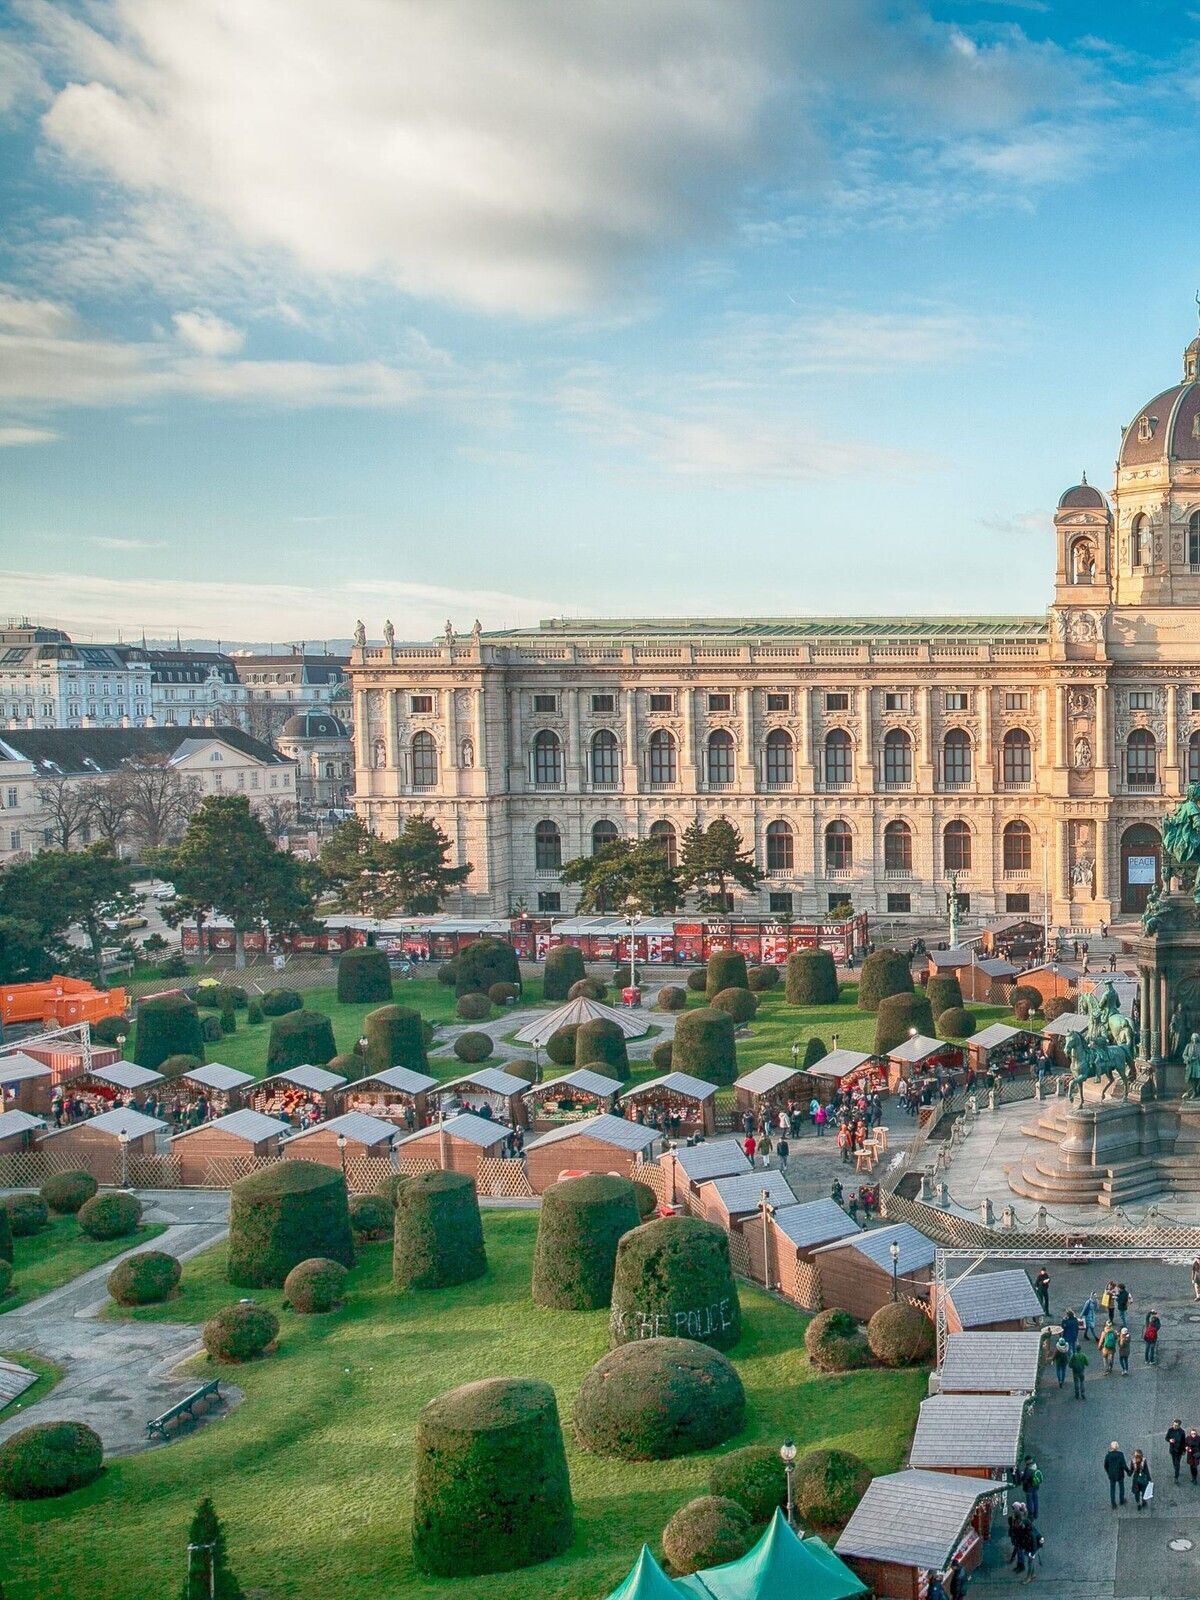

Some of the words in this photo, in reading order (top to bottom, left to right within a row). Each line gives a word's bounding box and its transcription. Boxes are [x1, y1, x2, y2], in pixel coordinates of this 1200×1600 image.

[707, 925, 726, 934] WC
[764, 925, 783, 934] WC
[822, 926, 841, 934] WC
[675, 1298, 731, 1338] POLICE
